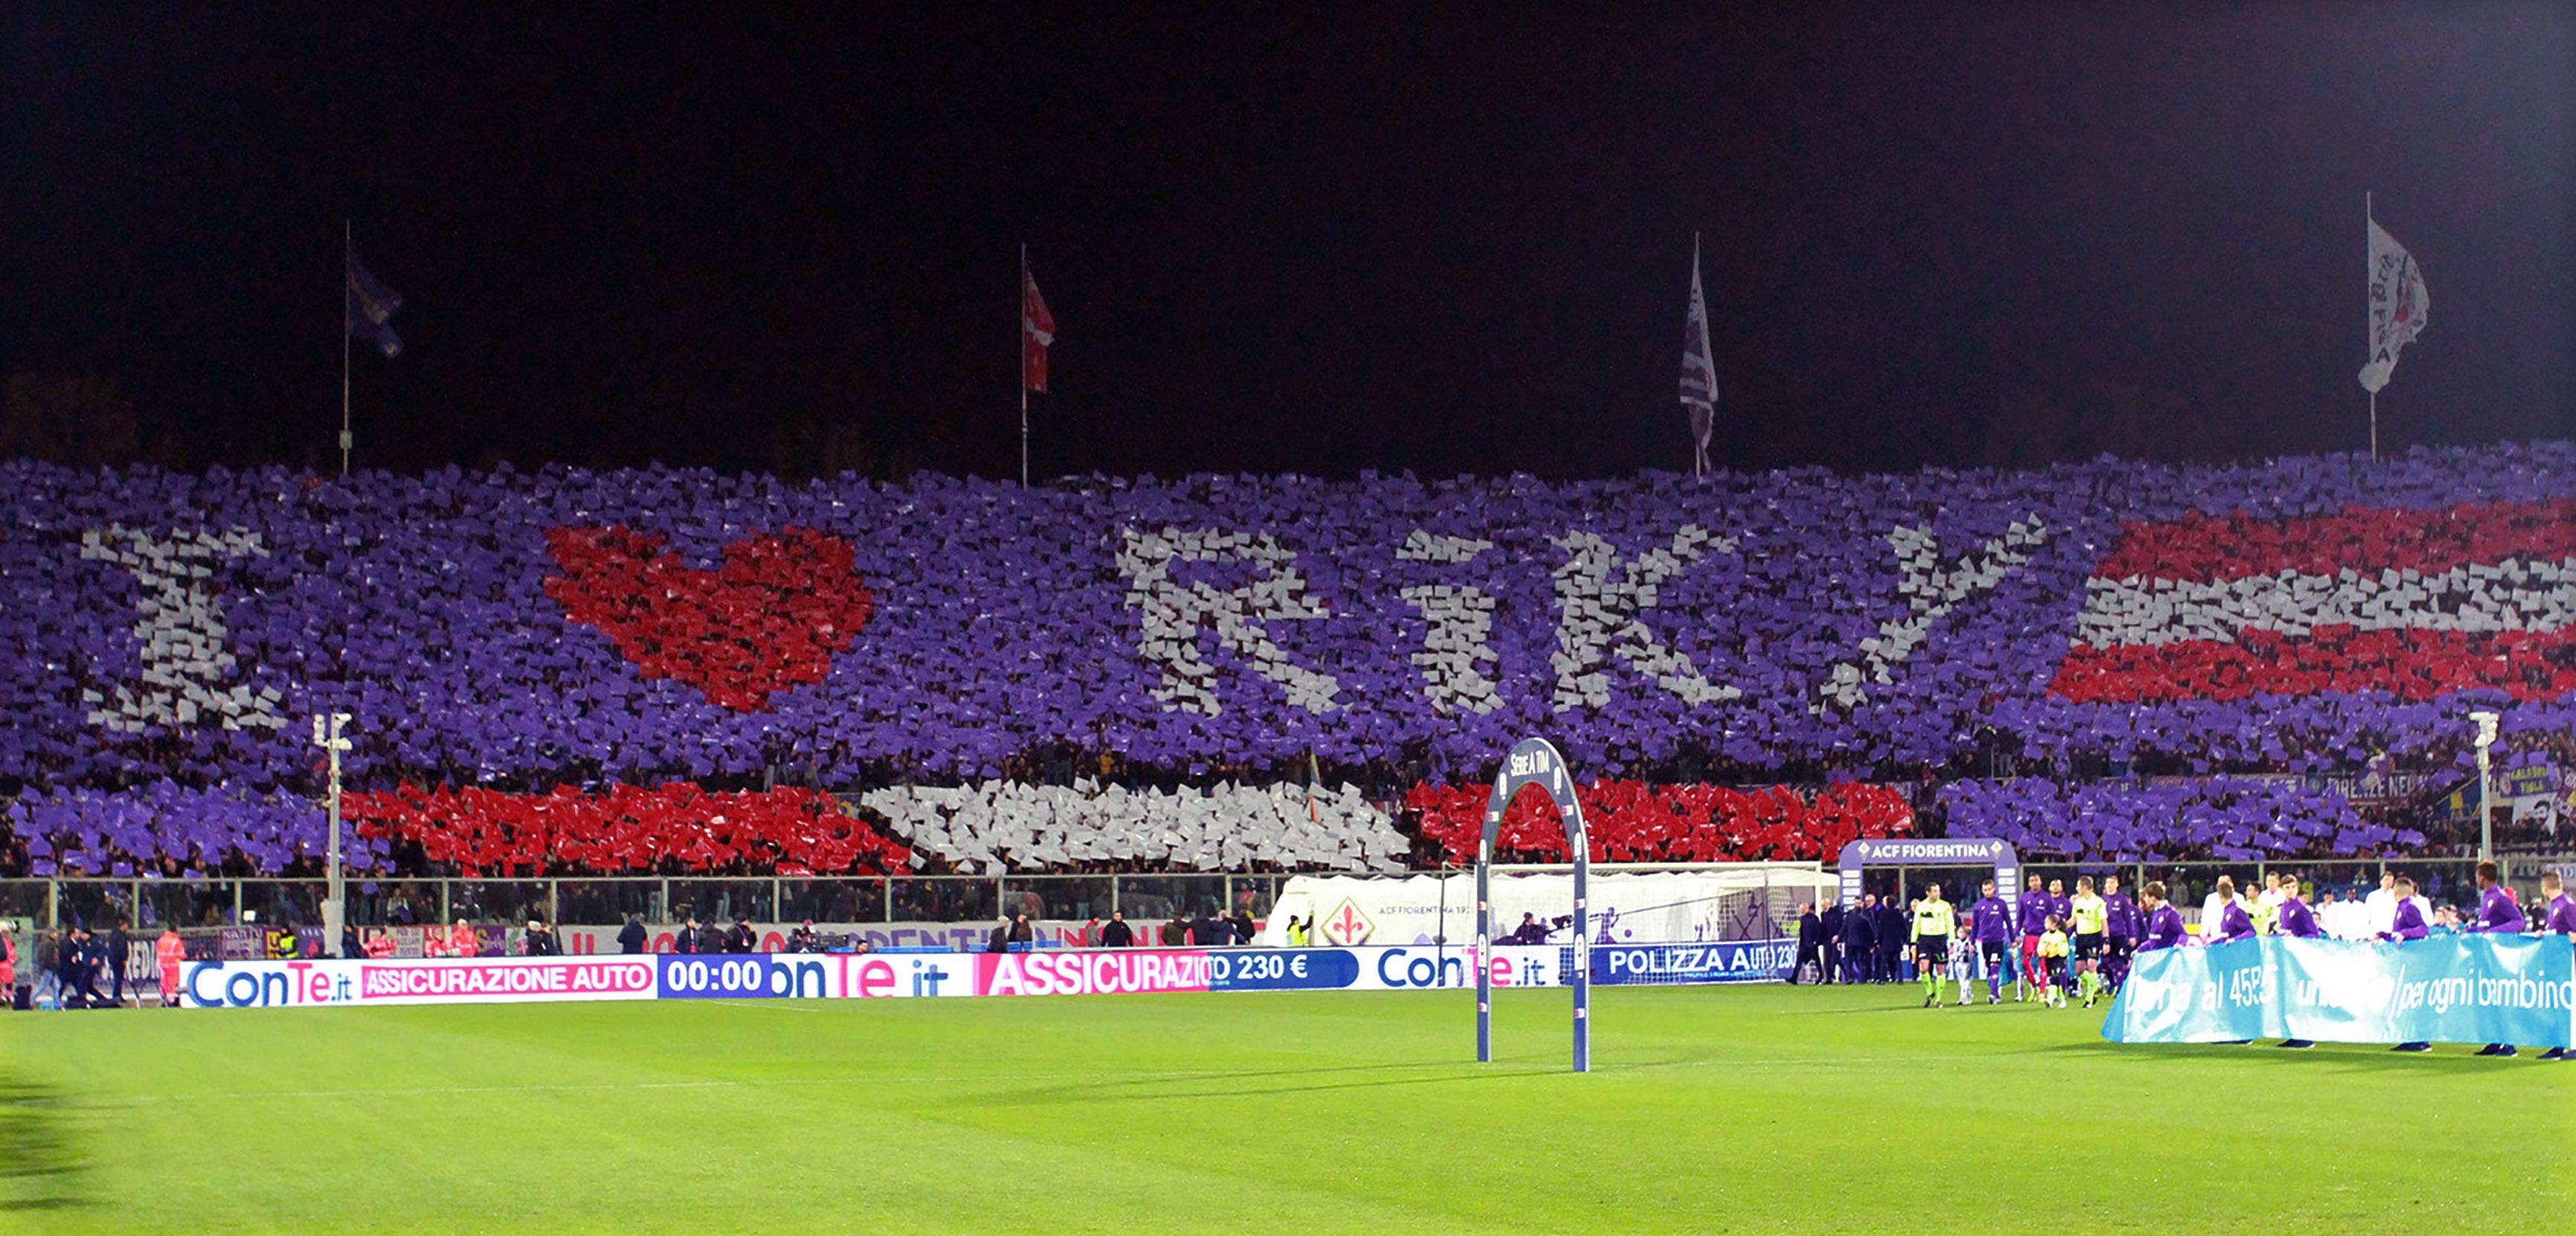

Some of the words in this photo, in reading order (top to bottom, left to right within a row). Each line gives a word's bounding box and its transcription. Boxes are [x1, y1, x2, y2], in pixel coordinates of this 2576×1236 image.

[1871, 844, 1900, 858] ACF
[1902, 844, 1989, 858] FIORENTINA
[1379, 906, 1396, 915] ACF
[1398, 905, 1454, 915] FIORENTNA
[1236, 954, 1285, 980] 230
[1289, 954, 1308, 979] €
[1610, 948, 1725, 974] POLIZZA
[187, 961, 352, 1008] ConTe.it
[366, 966, 567, 994] ASSICURAZIONE
[572, 965, 647, 991] AUTO
[668, 960, 762, 991] 00:00
[2201, 971, 2224, 1012] al
[2427, 968, 2474, 1014] ogni
